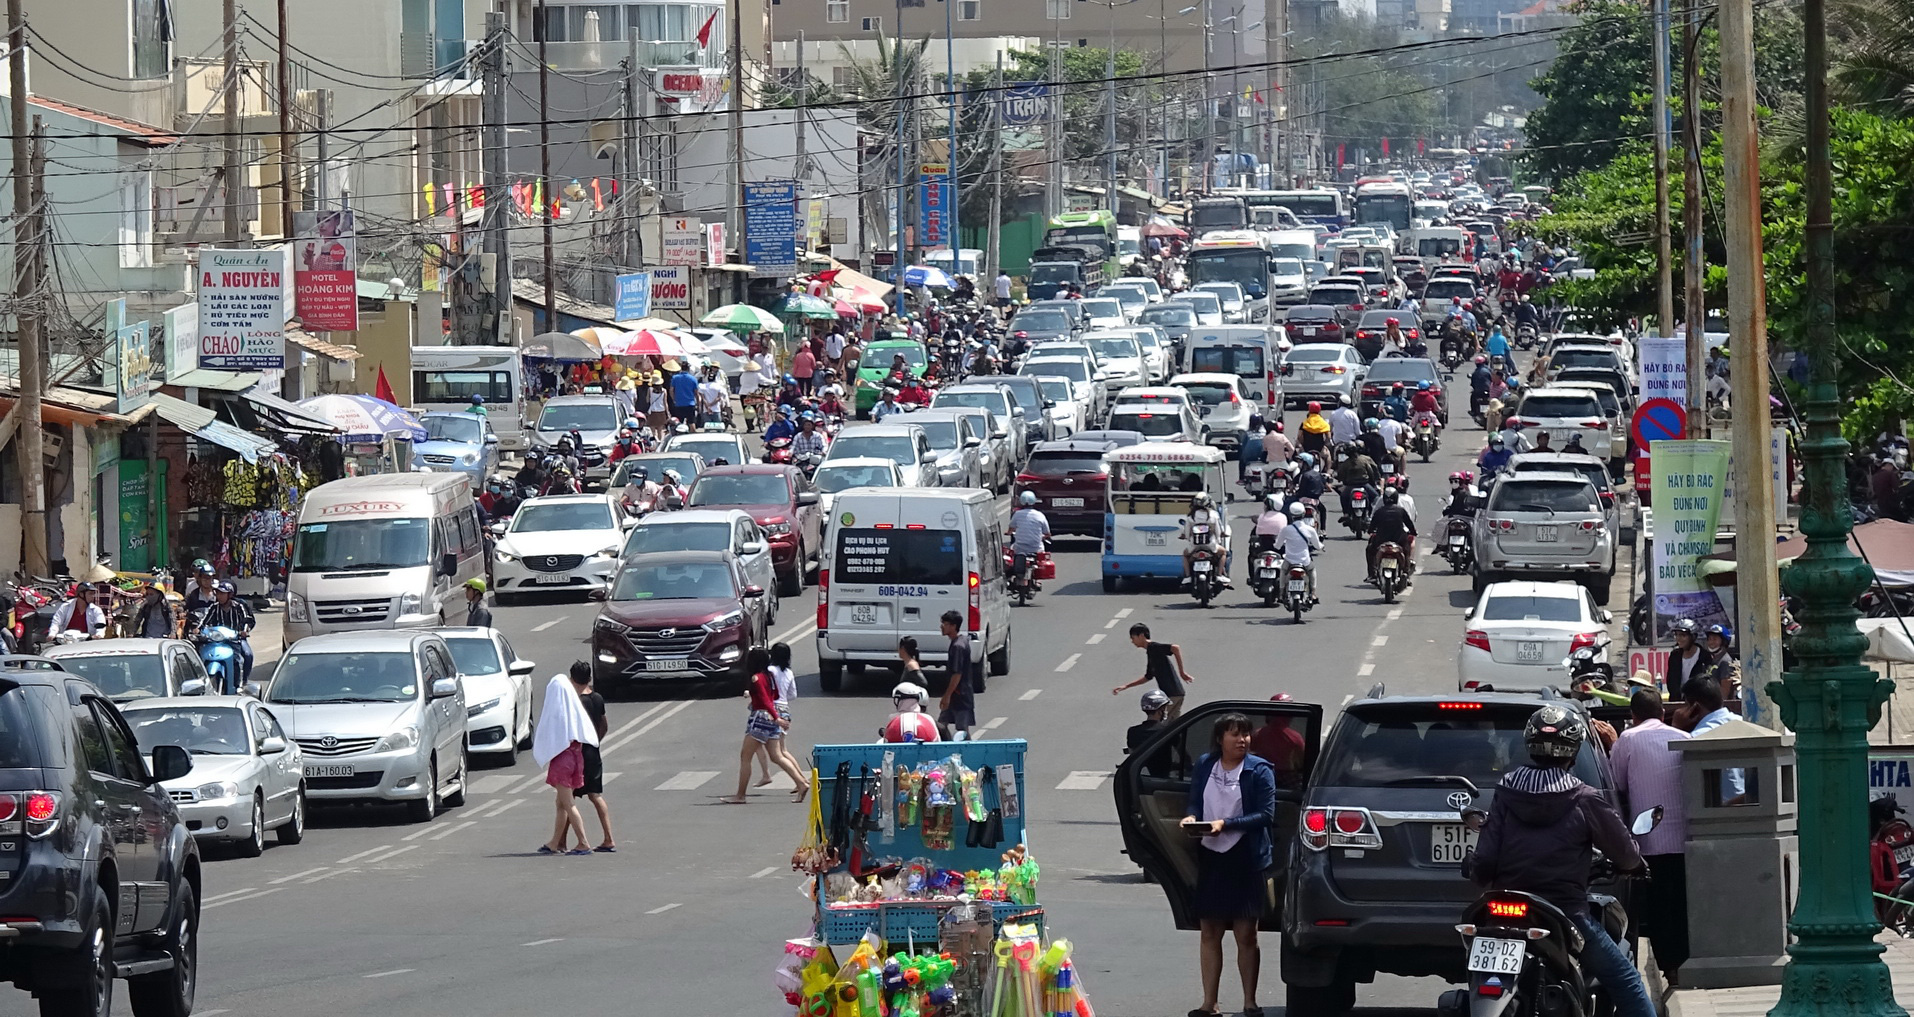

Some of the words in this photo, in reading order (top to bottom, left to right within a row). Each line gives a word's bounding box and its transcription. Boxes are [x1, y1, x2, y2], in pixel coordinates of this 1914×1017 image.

[214, 255, 243, 266] Quán
[203, 272, 216, 287] A.
[222, 268, 280, 287] NGUYÊN
[654, 267, 677, 278] NGHỈ
[298, 284, 333, 293] HOÀNG
[202, 331, 239, 354] CHÁO
[1676, 363, 1687, 373] RÁ
[1668, 472, 1684, 488] HÃY
[1697, 472, 1714, 488] RÁC
[321, 503, 406, 515] LUXURY
[128, 536, 147, 549] Spri
[1665, 542, 1676, 556] VÀ
[879, 586, 928, 596] 60B-042.94
[305, 766, 352, 776] 61A-160.03
[1444, 827, 1471, 843] 51F
[1433, 844, 1474, 861] 6106
[1480, 941, 1517, 957] 59-D2
[1472, 956, 1519, 972] 381.62
